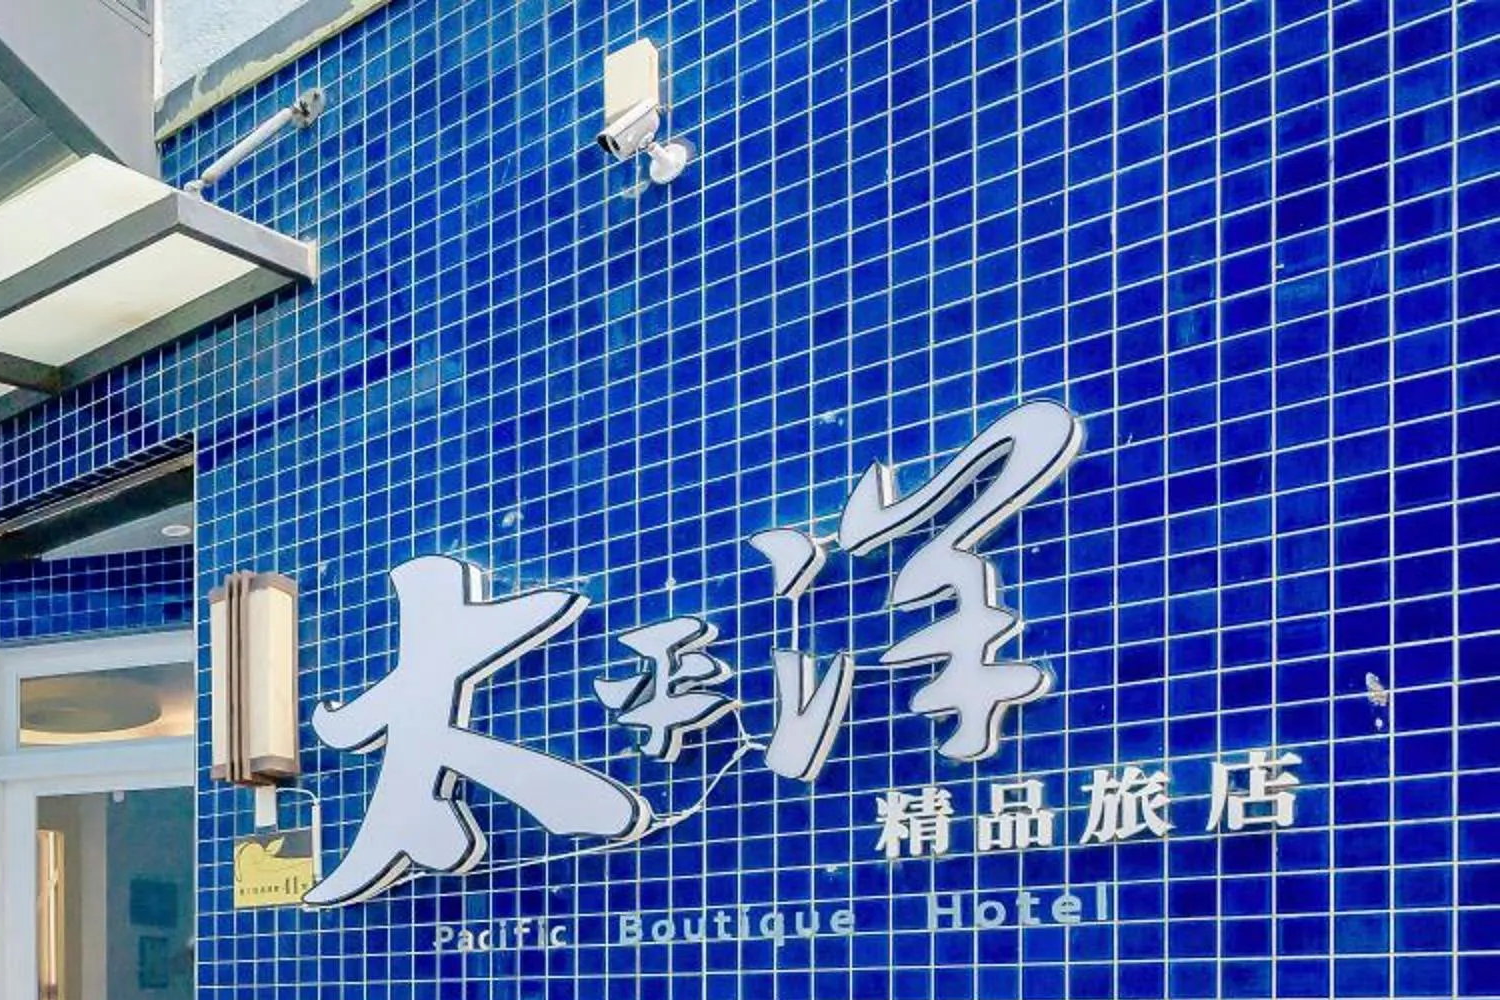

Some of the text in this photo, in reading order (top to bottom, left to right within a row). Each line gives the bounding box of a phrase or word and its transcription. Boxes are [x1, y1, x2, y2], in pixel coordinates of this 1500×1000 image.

[874, 750, 1303, 859] 精品旅店
[432, 887, 1112, 952] Pacific Boutique Hotel
